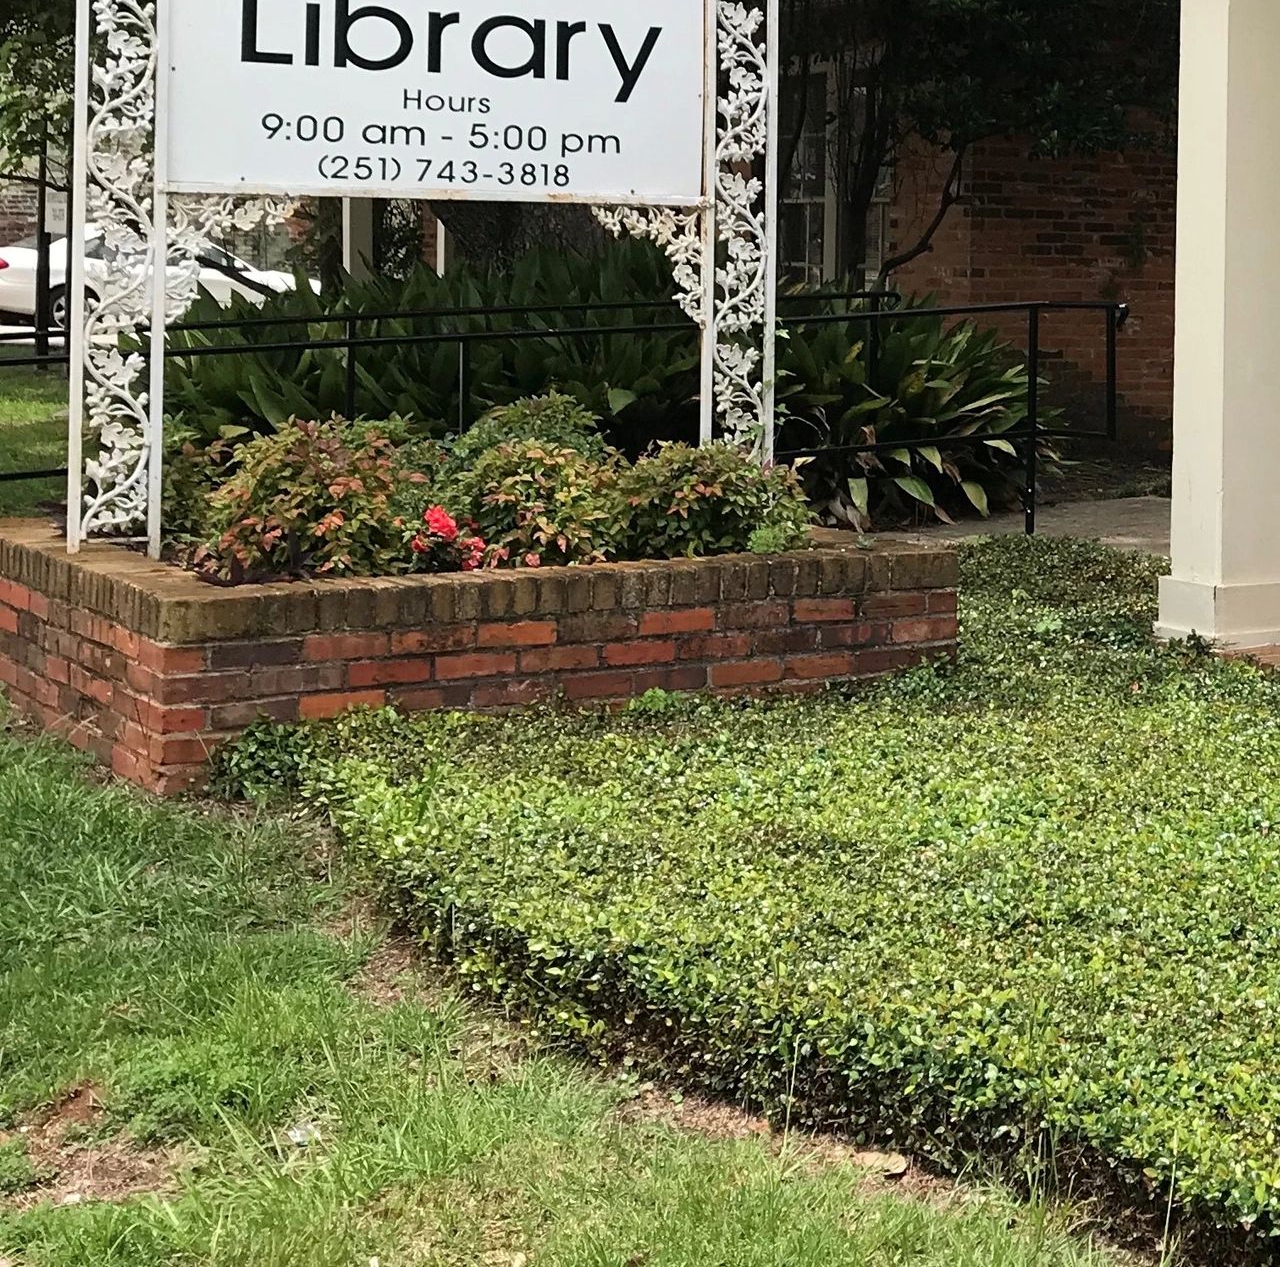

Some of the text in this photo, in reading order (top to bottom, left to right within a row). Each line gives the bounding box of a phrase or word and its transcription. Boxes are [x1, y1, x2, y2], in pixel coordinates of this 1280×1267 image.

[403, 88, 491, 114] Hours
[262, 114, 344, 143] 9:00
[362, 124, 426, 146] am
[469, 123, 547, 152] 5:00
[561, 134, 621, 158] pm
[318, 155, 570, 187] (251) 743-3818
